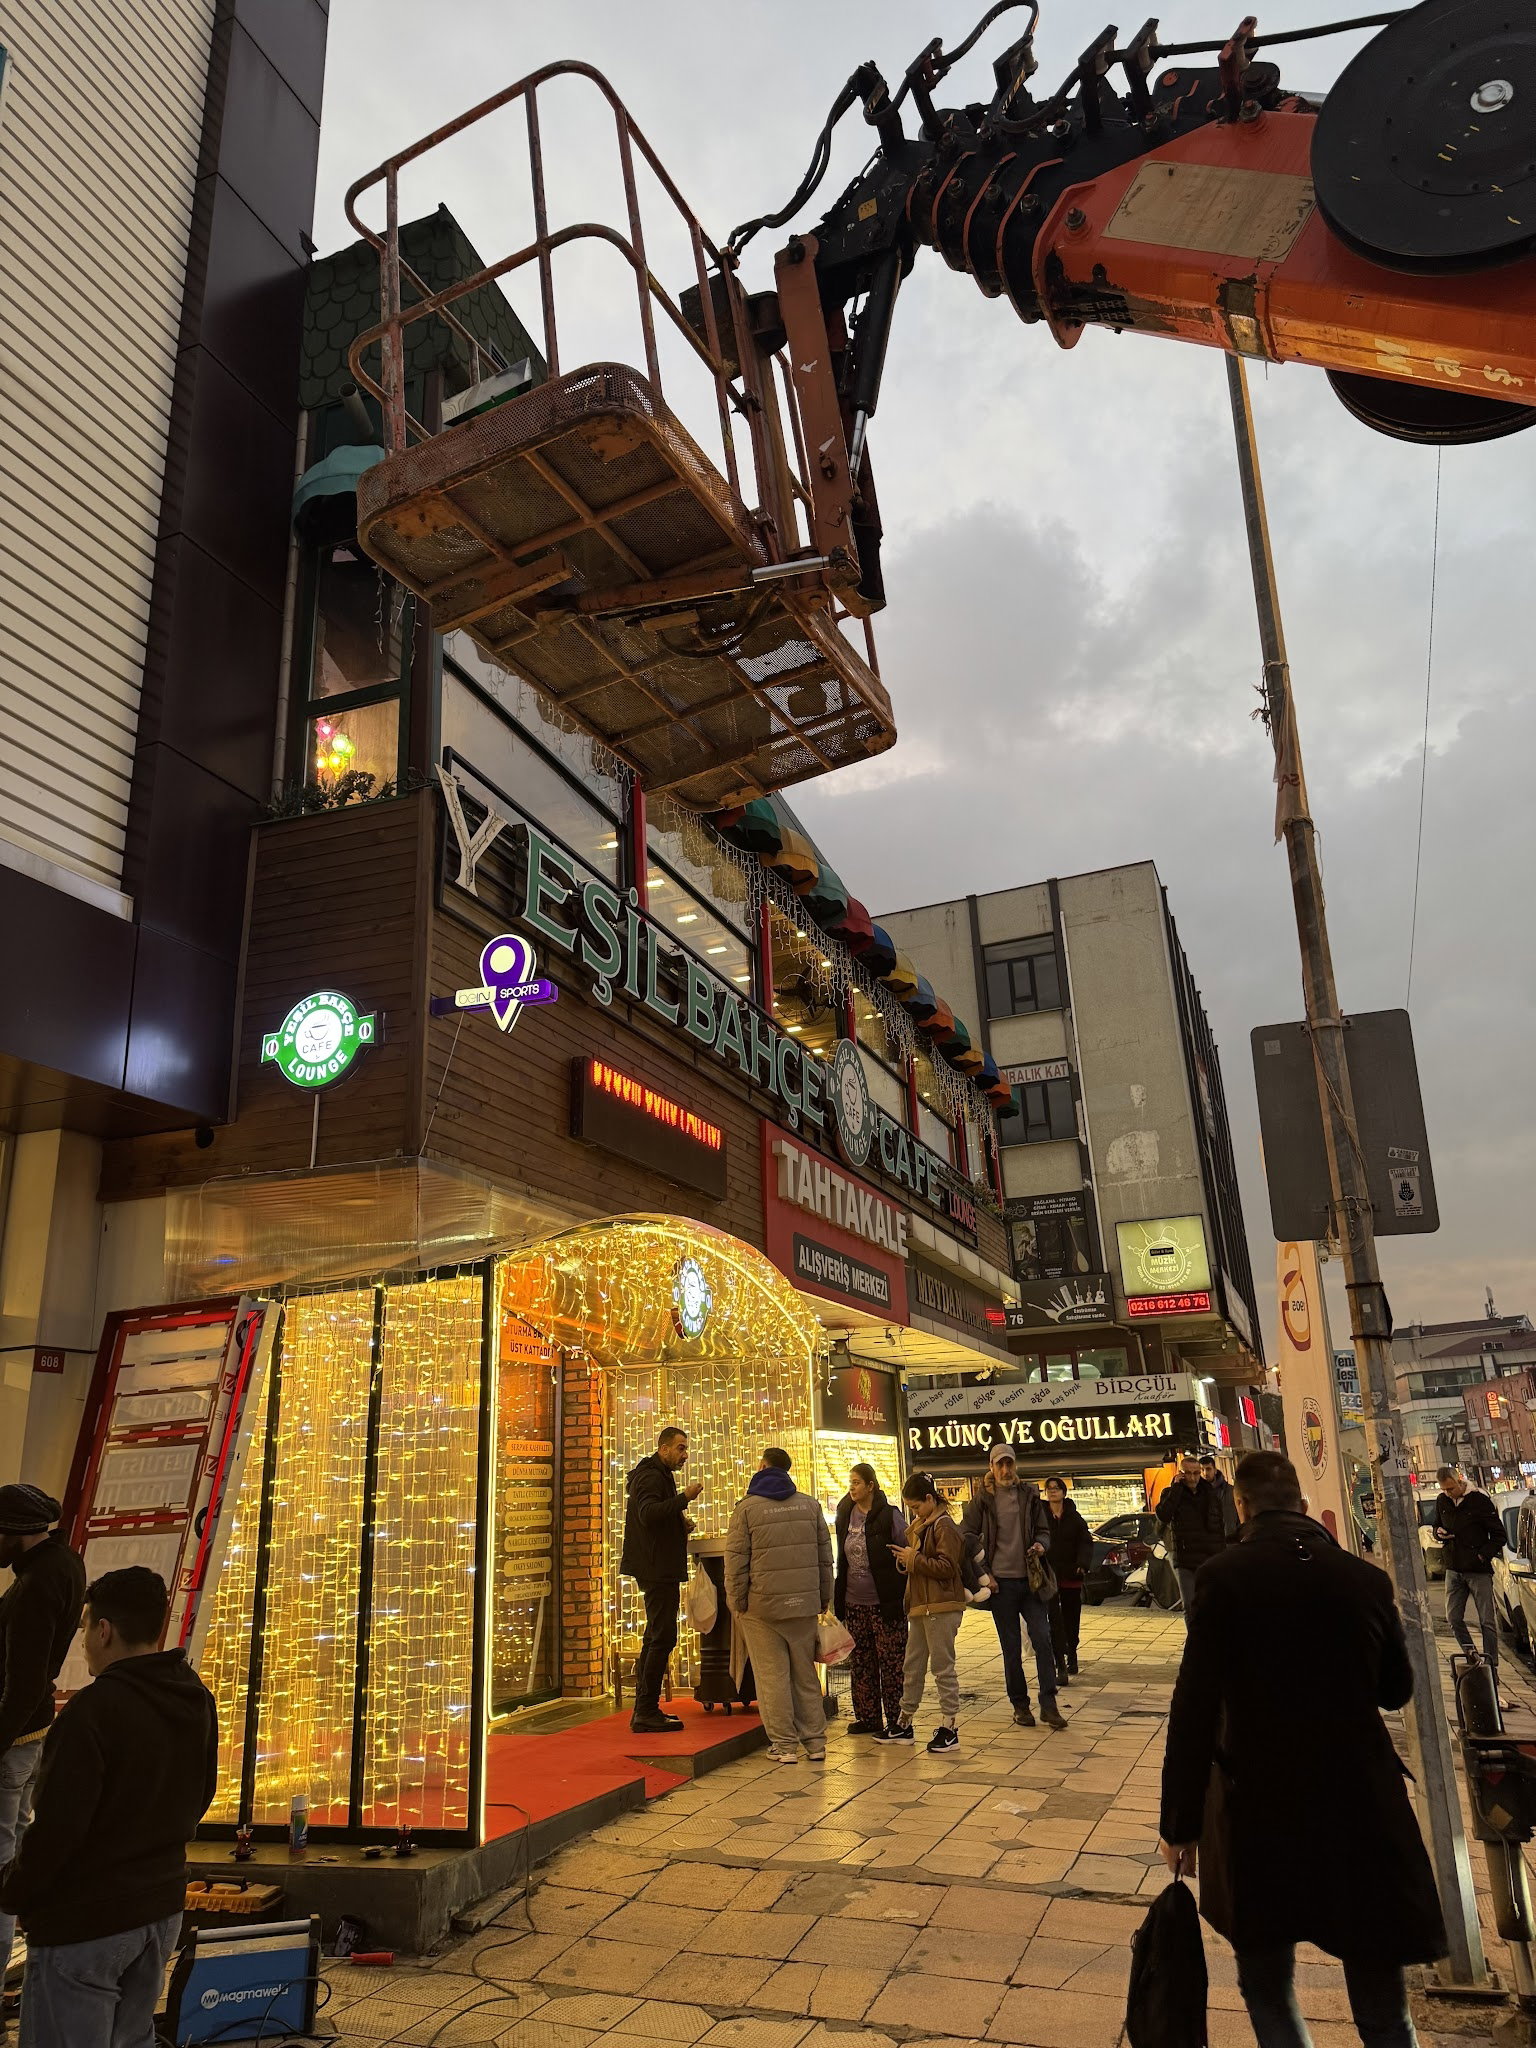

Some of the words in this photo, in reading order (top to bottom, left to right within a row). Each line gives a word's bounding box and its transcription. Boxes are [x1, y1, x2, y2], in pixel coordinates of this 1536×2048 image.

[500, 983, 540, 999] SPORTS
[302, 1040, 333, 1054] CAFE
[287, 1049, 349, 1081] LOUNGE
[1044, 1063, 1067, 1078] KAT
[878, 1117, 943, 1207] CAFE
[772, 1139, 910, 1259] TAHTAKALE
[949, 1189, 978, 1233] LOUNGE
[798, 1244, 850, 1293] ALIŞVERİŞ
[851, 1266, 889, 1302] MERKEZİ
[916, 1269, 963, 1321] MEYDAN
[1131, 1301, 1156, 1312] 0216
[1157, 1299, 1176, 1309] 612
[1177, 1297, 1191, 1308] 46
[1009, 1313, 1024, 1326] 76
[510, 1339, 523, 1354] ÜST
[40, 1355, 59, 1368] 608
[1030, 1386, 1051, 1405] ağda
[1049, 1394, 1064, 1407] kaş
[1064, 1383, 1083, 1399] bıyık
[1095, 1375, 1177, 1395] BİRGÜL
[912, 1399, 930, 1416] gelin
[928, 1390, 944, 1402] başı
[943, 1391, 964, 1410] röfle
[973, 1388, 996, 1410] gölge
[998, 1386, 1025, 1408] kesim
[929, 1420, 993, 1452] KÜNÇ
[999, 1417, 1035, 1445] VE
[1039, 1413, 1173, 1443] OĞULLARI
